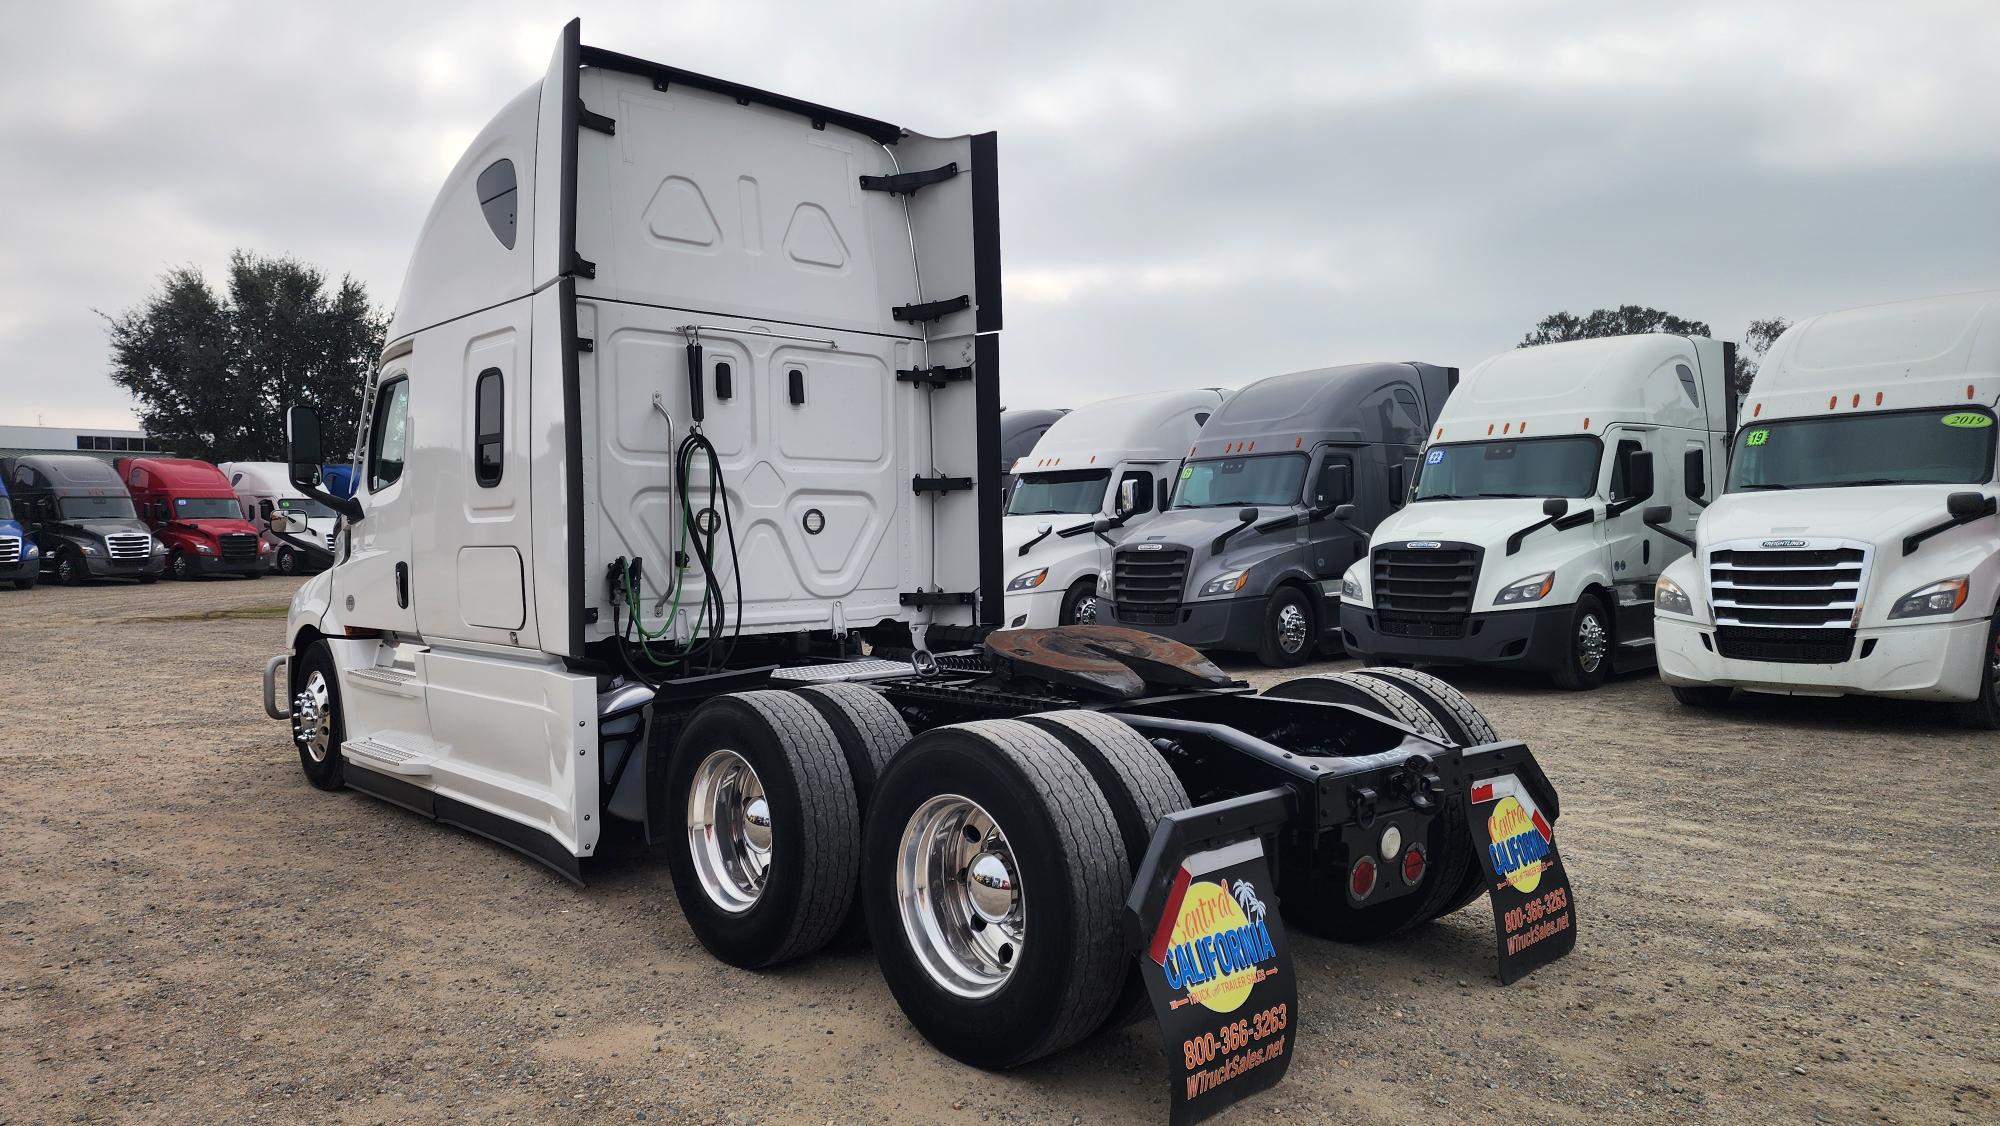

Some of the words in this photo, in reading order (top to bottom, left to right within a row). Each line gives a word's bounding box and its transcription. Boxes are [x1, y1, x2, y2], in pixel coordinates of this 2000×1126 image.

[1751, 432, 1763, 443] 19
[1950, 415, 1985, 425] 2019
[1487, 804, 1527, 844] Centra
[1172, 878, 1236, 946] entral
[1504, 887, 1568, 934] 800-366-3263
[1506, 910, 1570, 956] WTruckSales.net
[1164, 919, 1276, 991] CALIFORNIA
[1187, 985, 1210, 1005] TRUCK
[1221, 973, 1247, 995] TRAILER
[1246, 967, 1267, 985] SALES
[1183, 1003, 1287, 1070] 800-366-3263
[1186, 1034, 1286, 1101] WTruckSales.net
